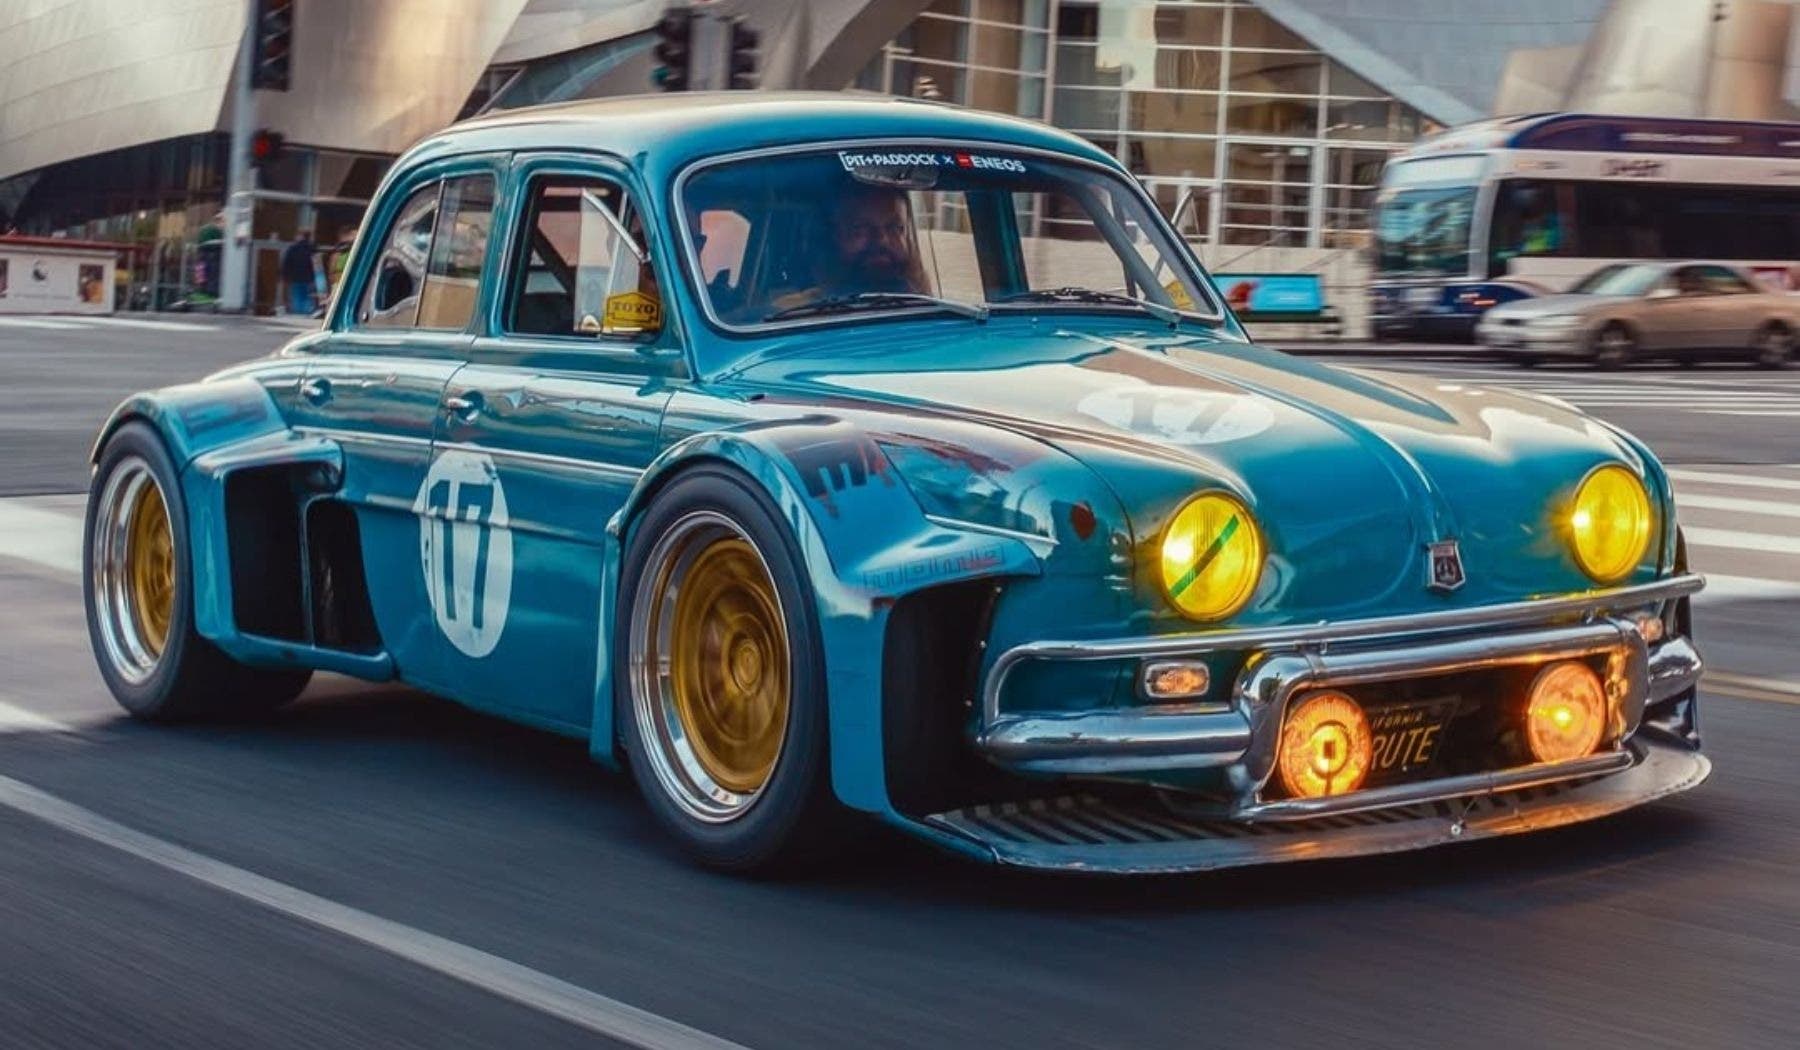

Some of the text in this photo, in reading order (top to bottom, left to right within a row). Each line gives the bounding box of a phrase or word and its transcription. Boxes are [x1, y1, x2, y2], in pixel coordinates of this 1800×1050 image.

[971, 155, 1026, 173] ENEOS
[429, 479, 495, 629] 17
[1372, 711, 1423, 728] IFORNIA
[1370, 724, 1441, 770] RUTE
